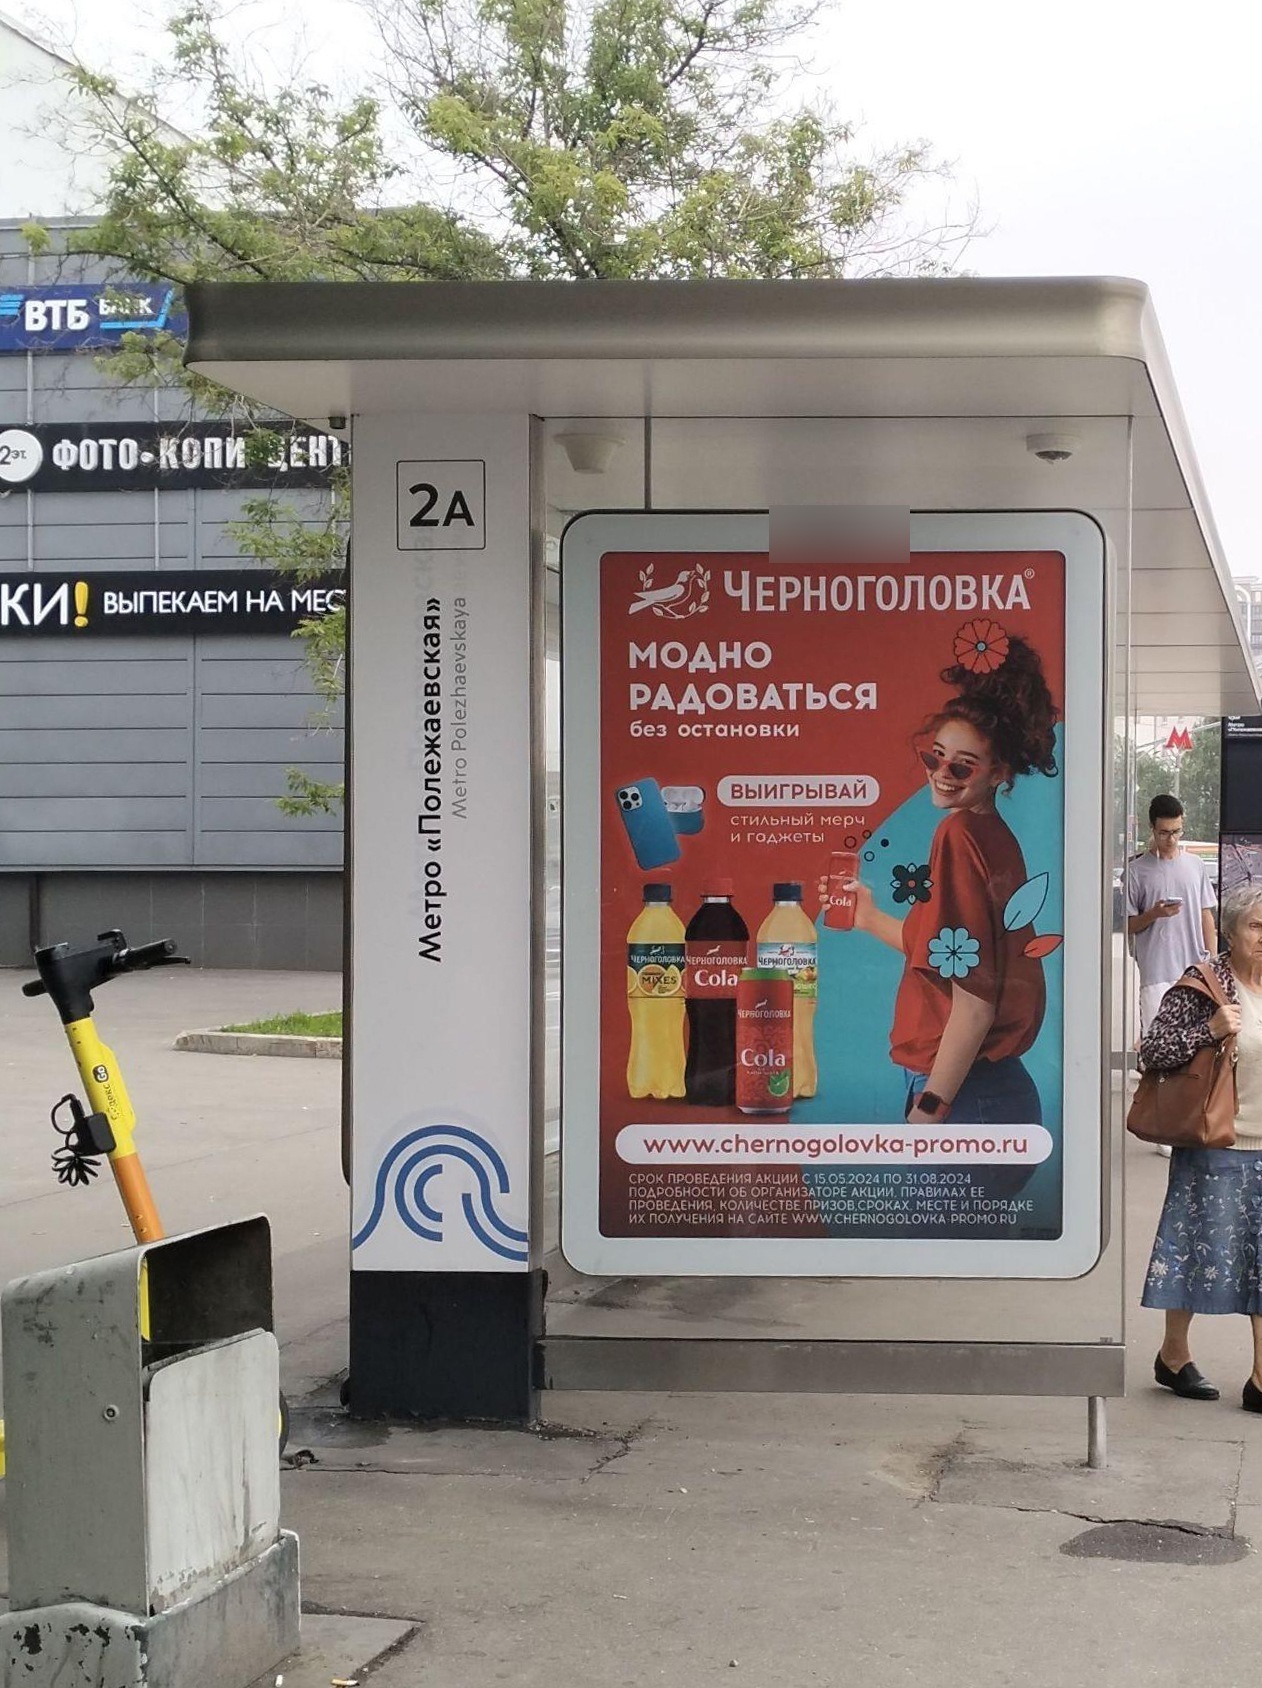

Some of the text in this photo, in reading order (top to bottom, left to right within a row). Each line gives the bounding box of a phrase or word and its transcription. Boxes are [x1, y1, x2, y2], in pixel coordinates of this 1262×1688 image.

[25, 299, 90, 331] ВТБ
[1, 581, 346, 627] КИ! ВЫПЕКАЕМ НА МЕС
[629, 641, 772, 673] МОДНО
[450, 597, 469, 819] Metro Polezhaevskaya
[630, 682, 877, 715] РАДОВАТЬСЯ
[418, 597, 441, 852] «Полежаевская»
[630, 720, 799, 737] без остановки
[731, 779, 867, 799] ВЫИГРЫВАЙ
[731, 813, 865, 829] стильный мерч
[731, 832, 824, 844] и гаджеты
[829, 896, 852, 907] Cola
[419, 861, 447, 962] Метро
[694, 969, 738, 987] Cola
[741, 1048, 786, 1067] Cola
[643, 1133, 1028, 1158] www.chernogolovka-promo.ru
[629, 1173, 971, 1186] СРОК ПРОВЕДЕНИЯ АКЦИИ С 15.05.2024 ПО 31.08.2024
[629, 1186, 725, 1199] ПОДРОБНОСТИ
[729, 1186, 747, 1198] ОБ
[750, 1186, 847, 1198] ОРГАНИЗАТОРЕ
[901, 1186, 967, 1198] ПРАВИЛАХ
[971, 1186, 985, 1198] ЕЕ
[719, 1200, 801, 1211] КОЛИЧЕСТВЕ
[916, 1199, 958, 1211] МЕСТЕ
[960, 1200, 970, 1211] И
[973, 1200, 1034, 1212] ПОРЯДКЕ
[629, 1213, 646, 1224] ИХ
[650, 1213, 724, 1224] ПОЛУЧЕНИЯ
[728, 1213, 744, 1224] НА
[748, 1211, 788, 1224] САЙТЕ
